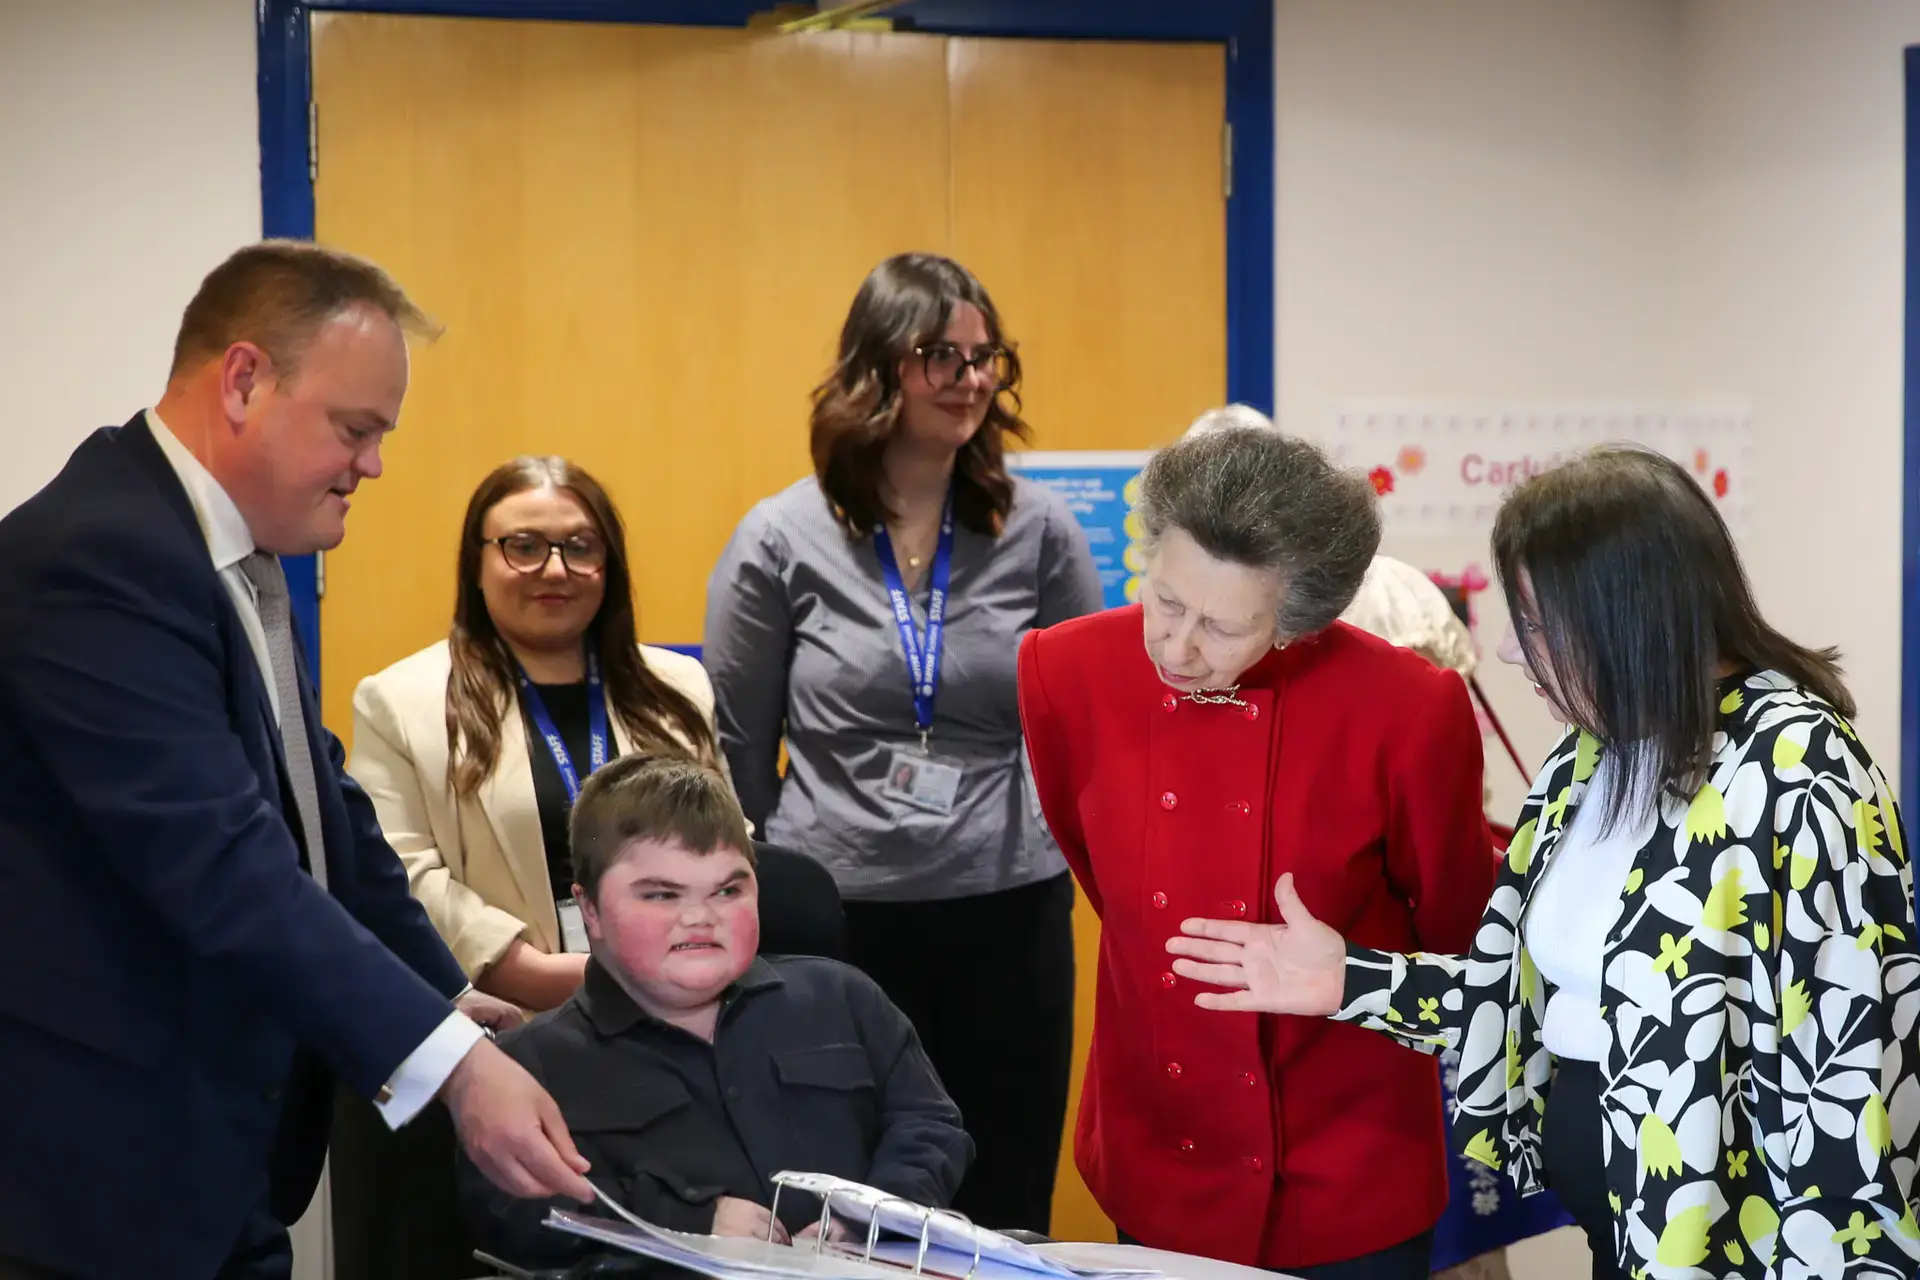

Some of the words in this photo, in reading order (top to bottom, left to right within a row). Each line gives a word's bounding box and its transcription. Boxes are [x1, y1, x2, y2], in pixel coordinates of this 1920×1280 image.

[890, 588, 910, 622] STAFF
[929, 587, 944, 621] STAFF
[545, 734, 569, 765] STAFF
[592, 734, 604, 764] STAFF
